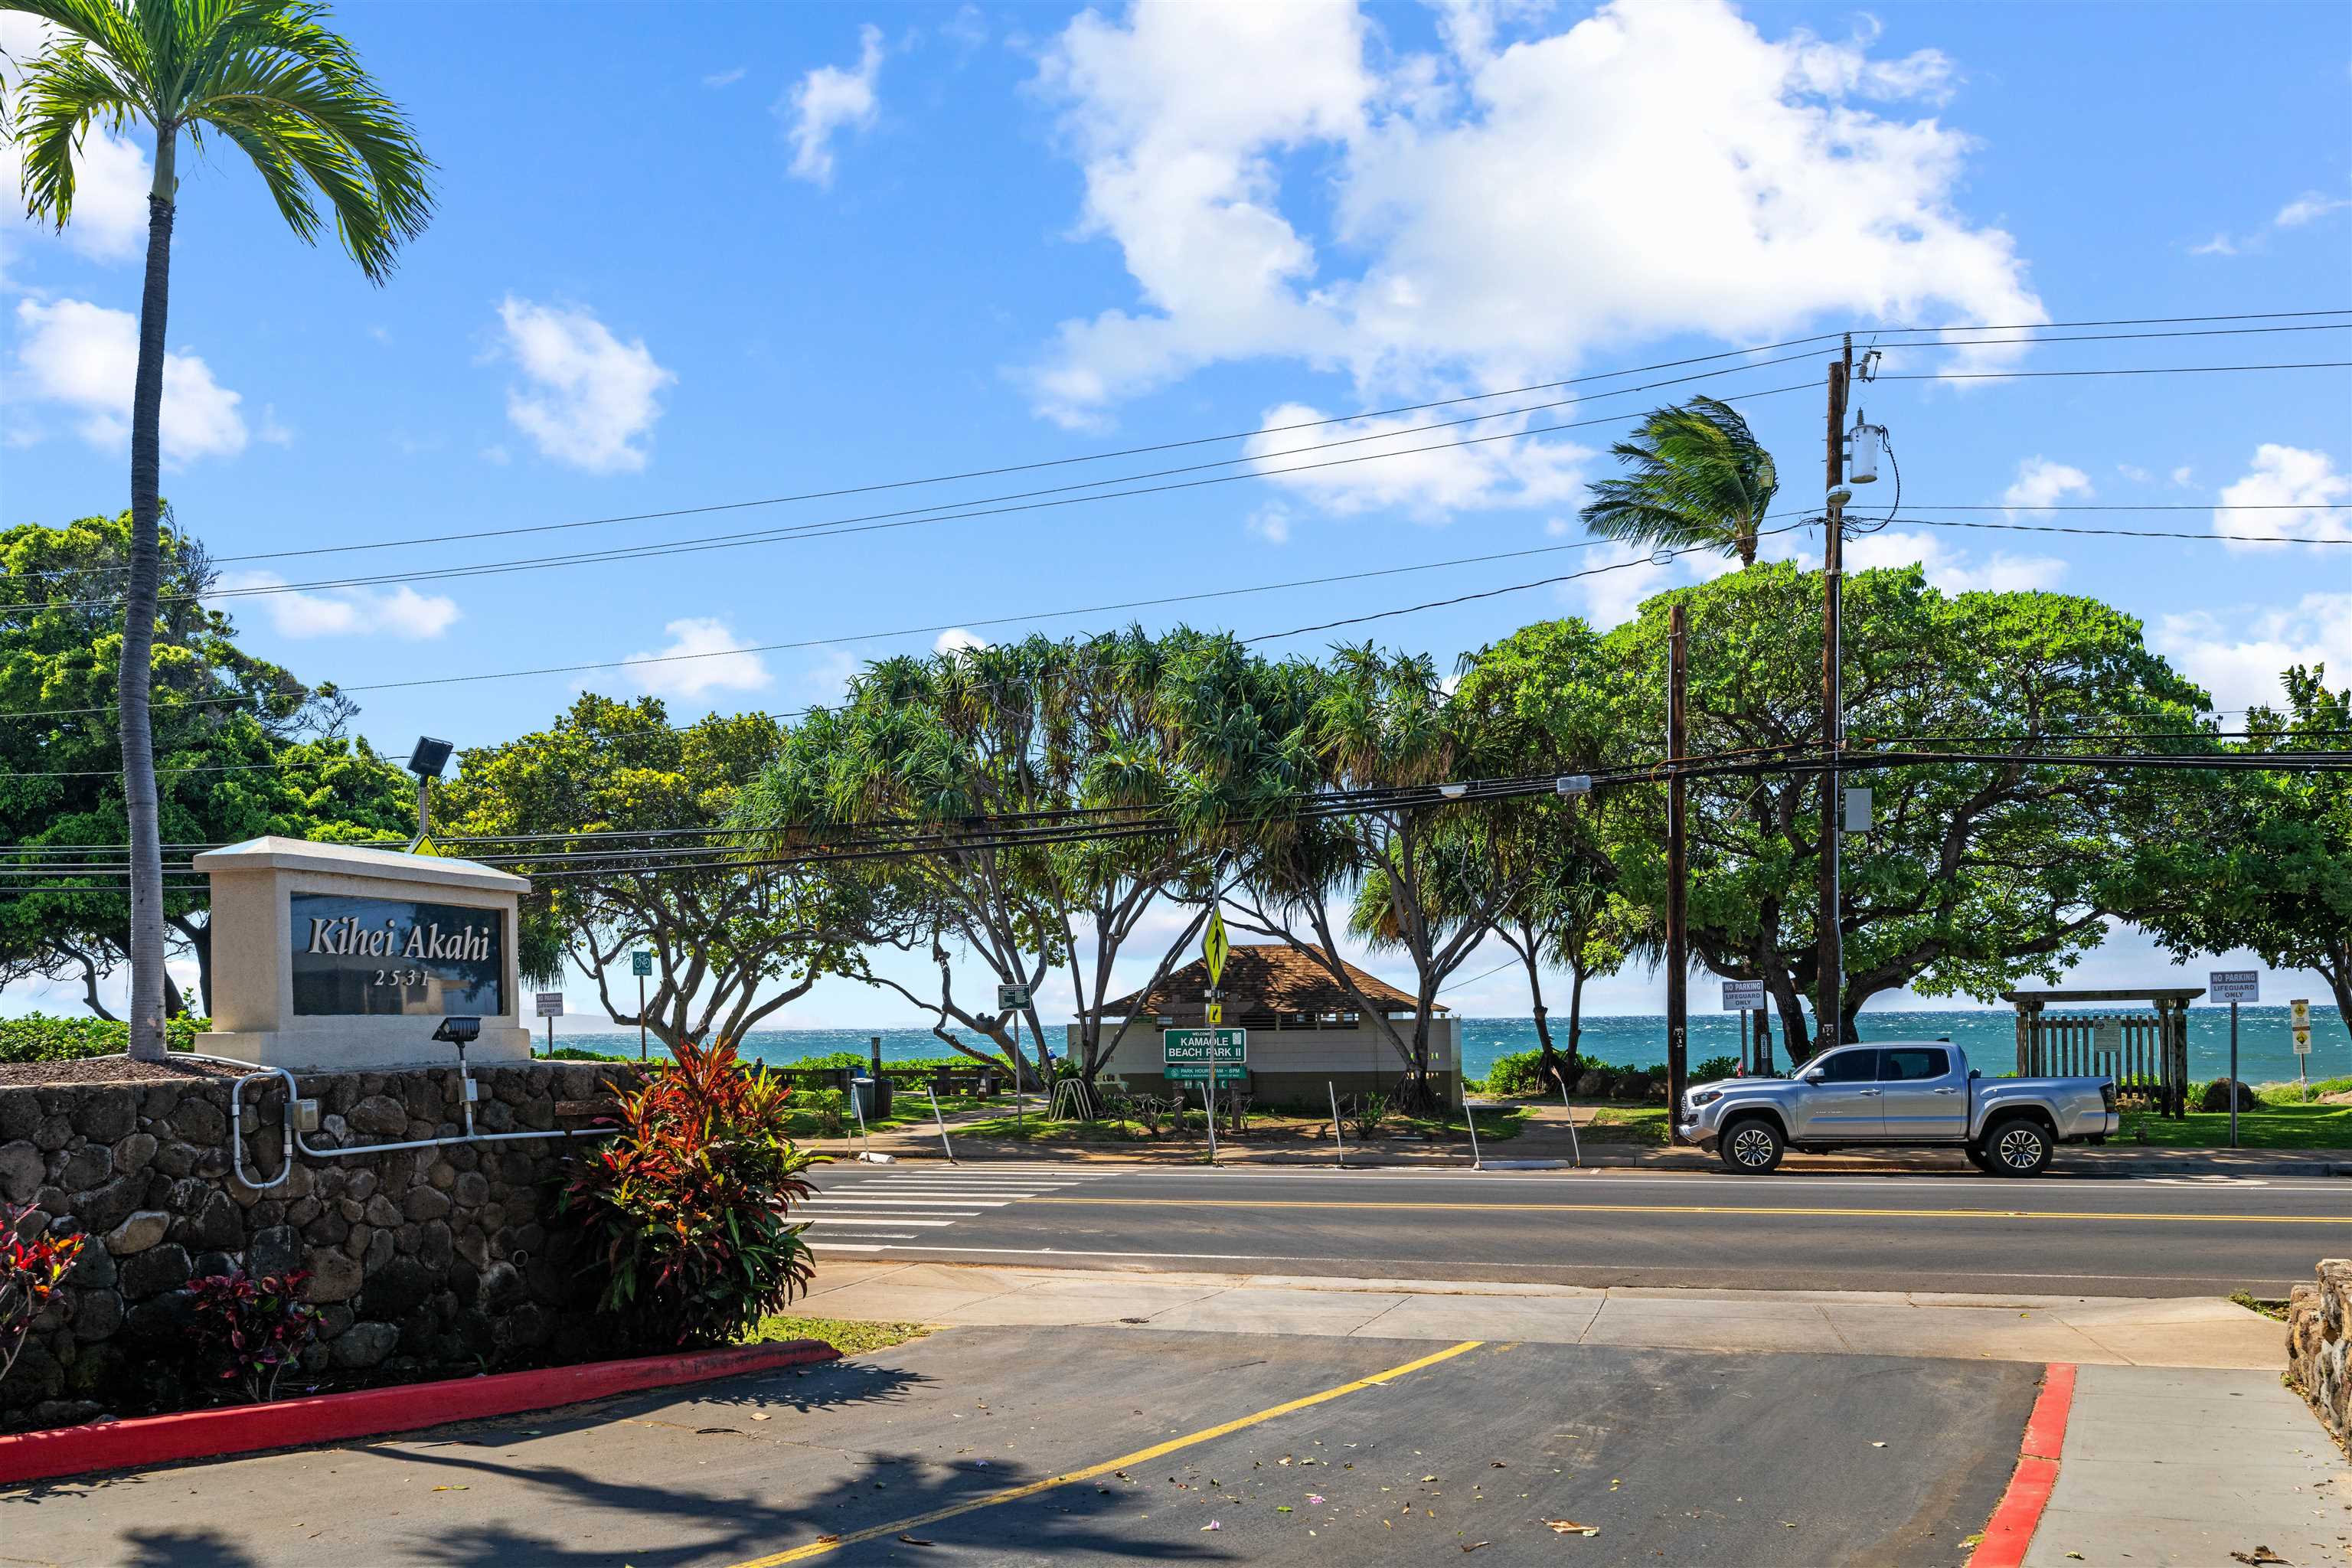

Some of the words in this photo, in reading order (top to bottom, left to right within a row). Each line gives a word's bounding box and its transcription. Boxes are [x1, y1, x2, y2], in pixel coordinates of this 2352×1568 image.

[307, 916, 397, 957] Kihei
[401, 923, 490, 962] Akahi
[374, 969, 430, 986] 2531
[2213, 974, 2223, 982] NO
[2225, 973, 2256, 982] PARKING
[1724, 983, 1733, 992] NO
[1735, 982, 1761, 991] PARKING
[1168, 1048, 1202, 1057] BEACH
[1206, 1048, 1232, 1057] PARK
